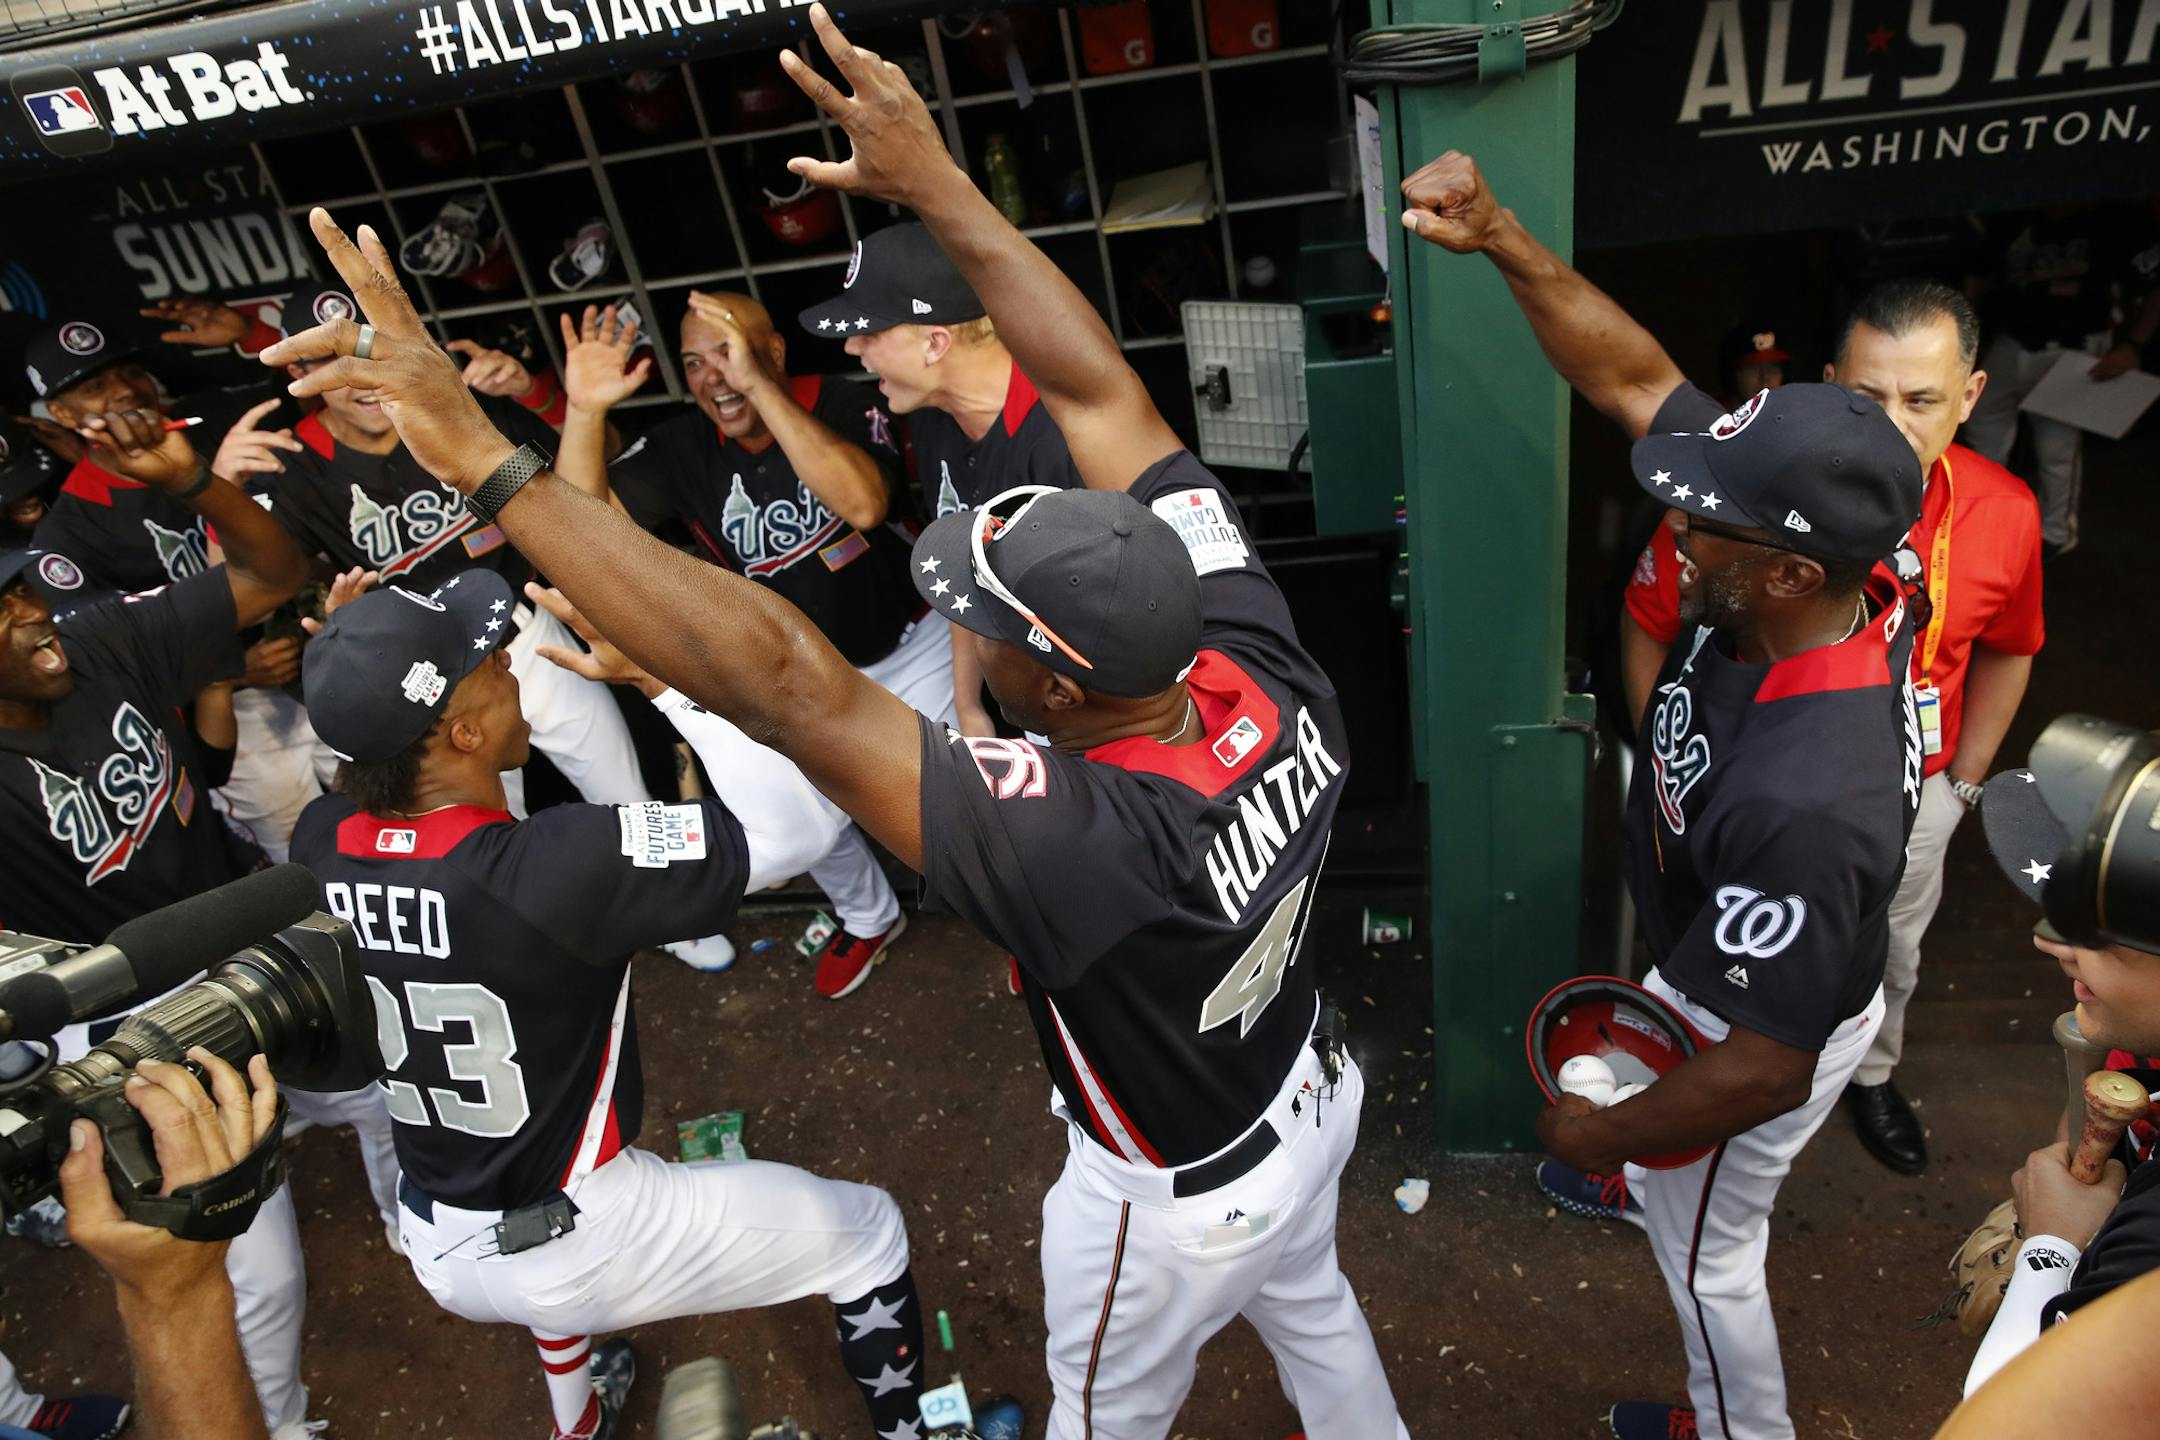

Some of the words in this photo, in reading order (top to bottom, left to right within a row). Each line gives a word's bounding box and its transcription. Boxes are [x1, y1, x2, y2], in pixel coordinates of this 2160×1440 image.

[416, 0, 820, 75] #ALLSTAR
[1123, 39, 1146, 66] G
[1252, 22, 1273, 48] G
[1676, 0, 1874, 124] ALL
[1899, 0, 2160, 98] STA
[93, 64, 189, 136] At
[1761, 104, 2151, 175] WASHINGTON,
[115, 177, 190, 217] ALL
[409, 664, 436, 701] FUTURES
[421, 676, 440, 699] GAME
[48, 701, 167, 864] USA
[644, 802, 665, 865] FUTURES
[664, 811, 686, 850] GAME
[1205, 705, 1341, 925] HUNTER
[325, 882, 451, 960] REED
[203, 1188, 256, 1216] Canon
[2023, 1247, 2070, 1268] adidas
